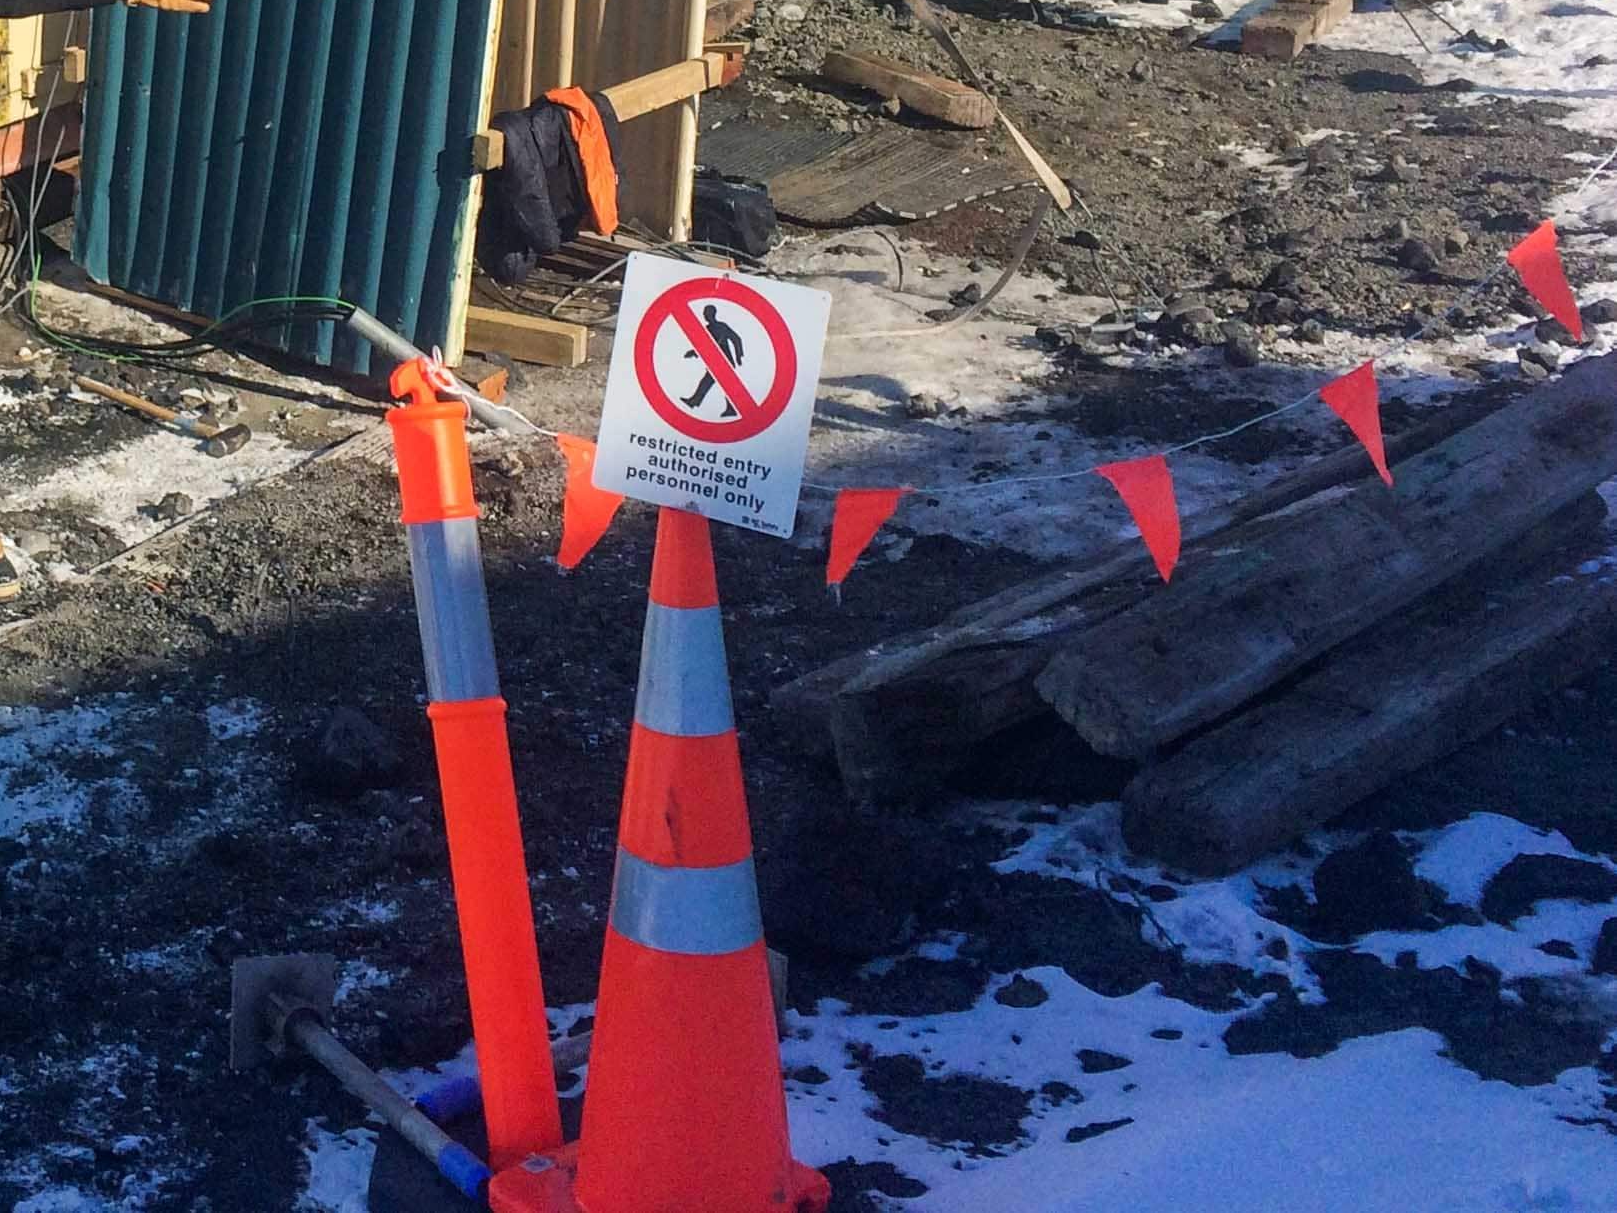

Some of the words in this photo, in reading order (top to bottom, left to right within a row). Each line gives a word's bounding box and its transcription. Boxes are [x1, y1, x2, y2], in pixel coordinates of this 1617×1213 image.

[629, 432, 718, 465] restricted
[723, 456, 772, 481] entry
[647, 454, 749, 489] authorised
[625, 465, 719, 499] personnel
[724, 491, 766, 514] only
